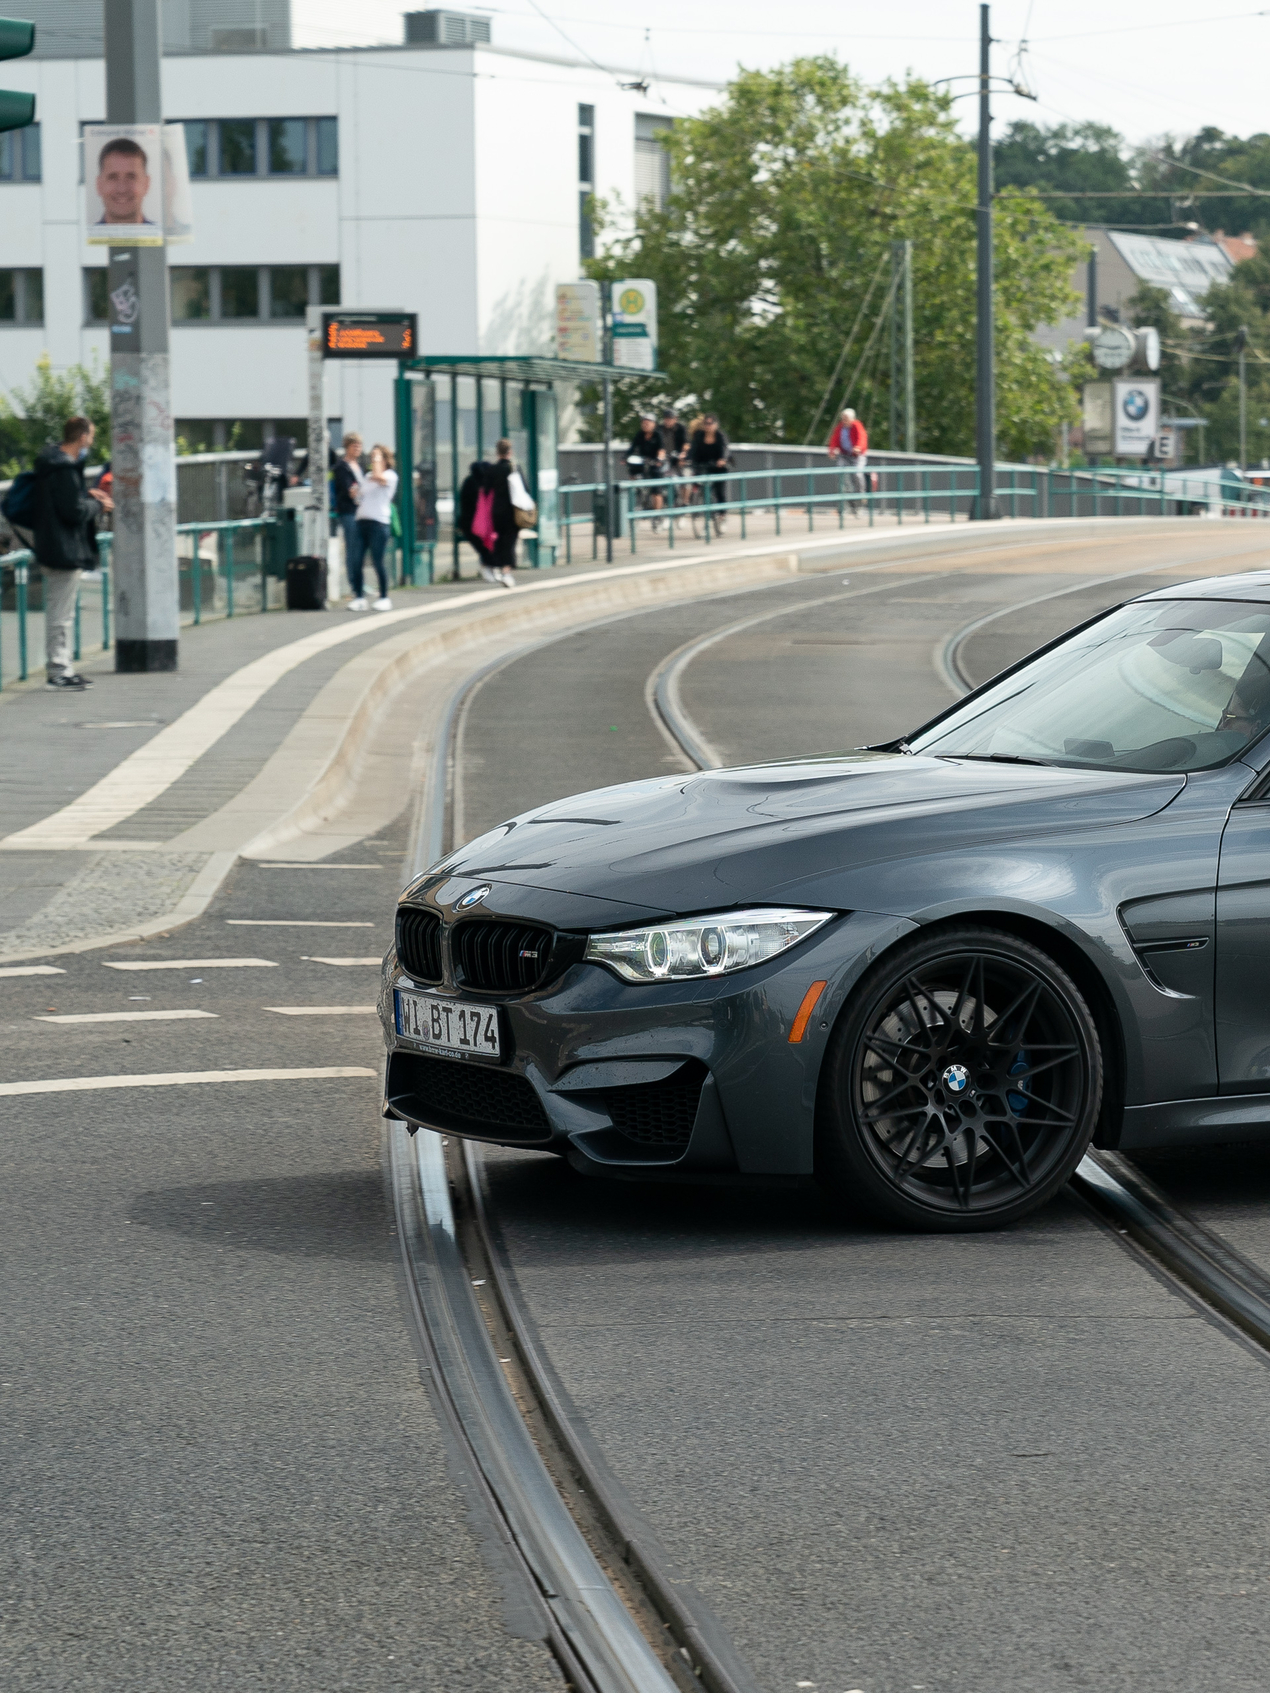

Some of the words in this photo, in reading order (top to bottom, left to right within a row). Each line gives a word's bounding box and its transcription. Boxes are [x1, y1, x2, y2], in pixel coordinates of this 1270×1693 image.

[402, 997, 420, 1035] WI
[431, 1004, 452, 1042] BT
[459, 1010, 497, 1050] 174
